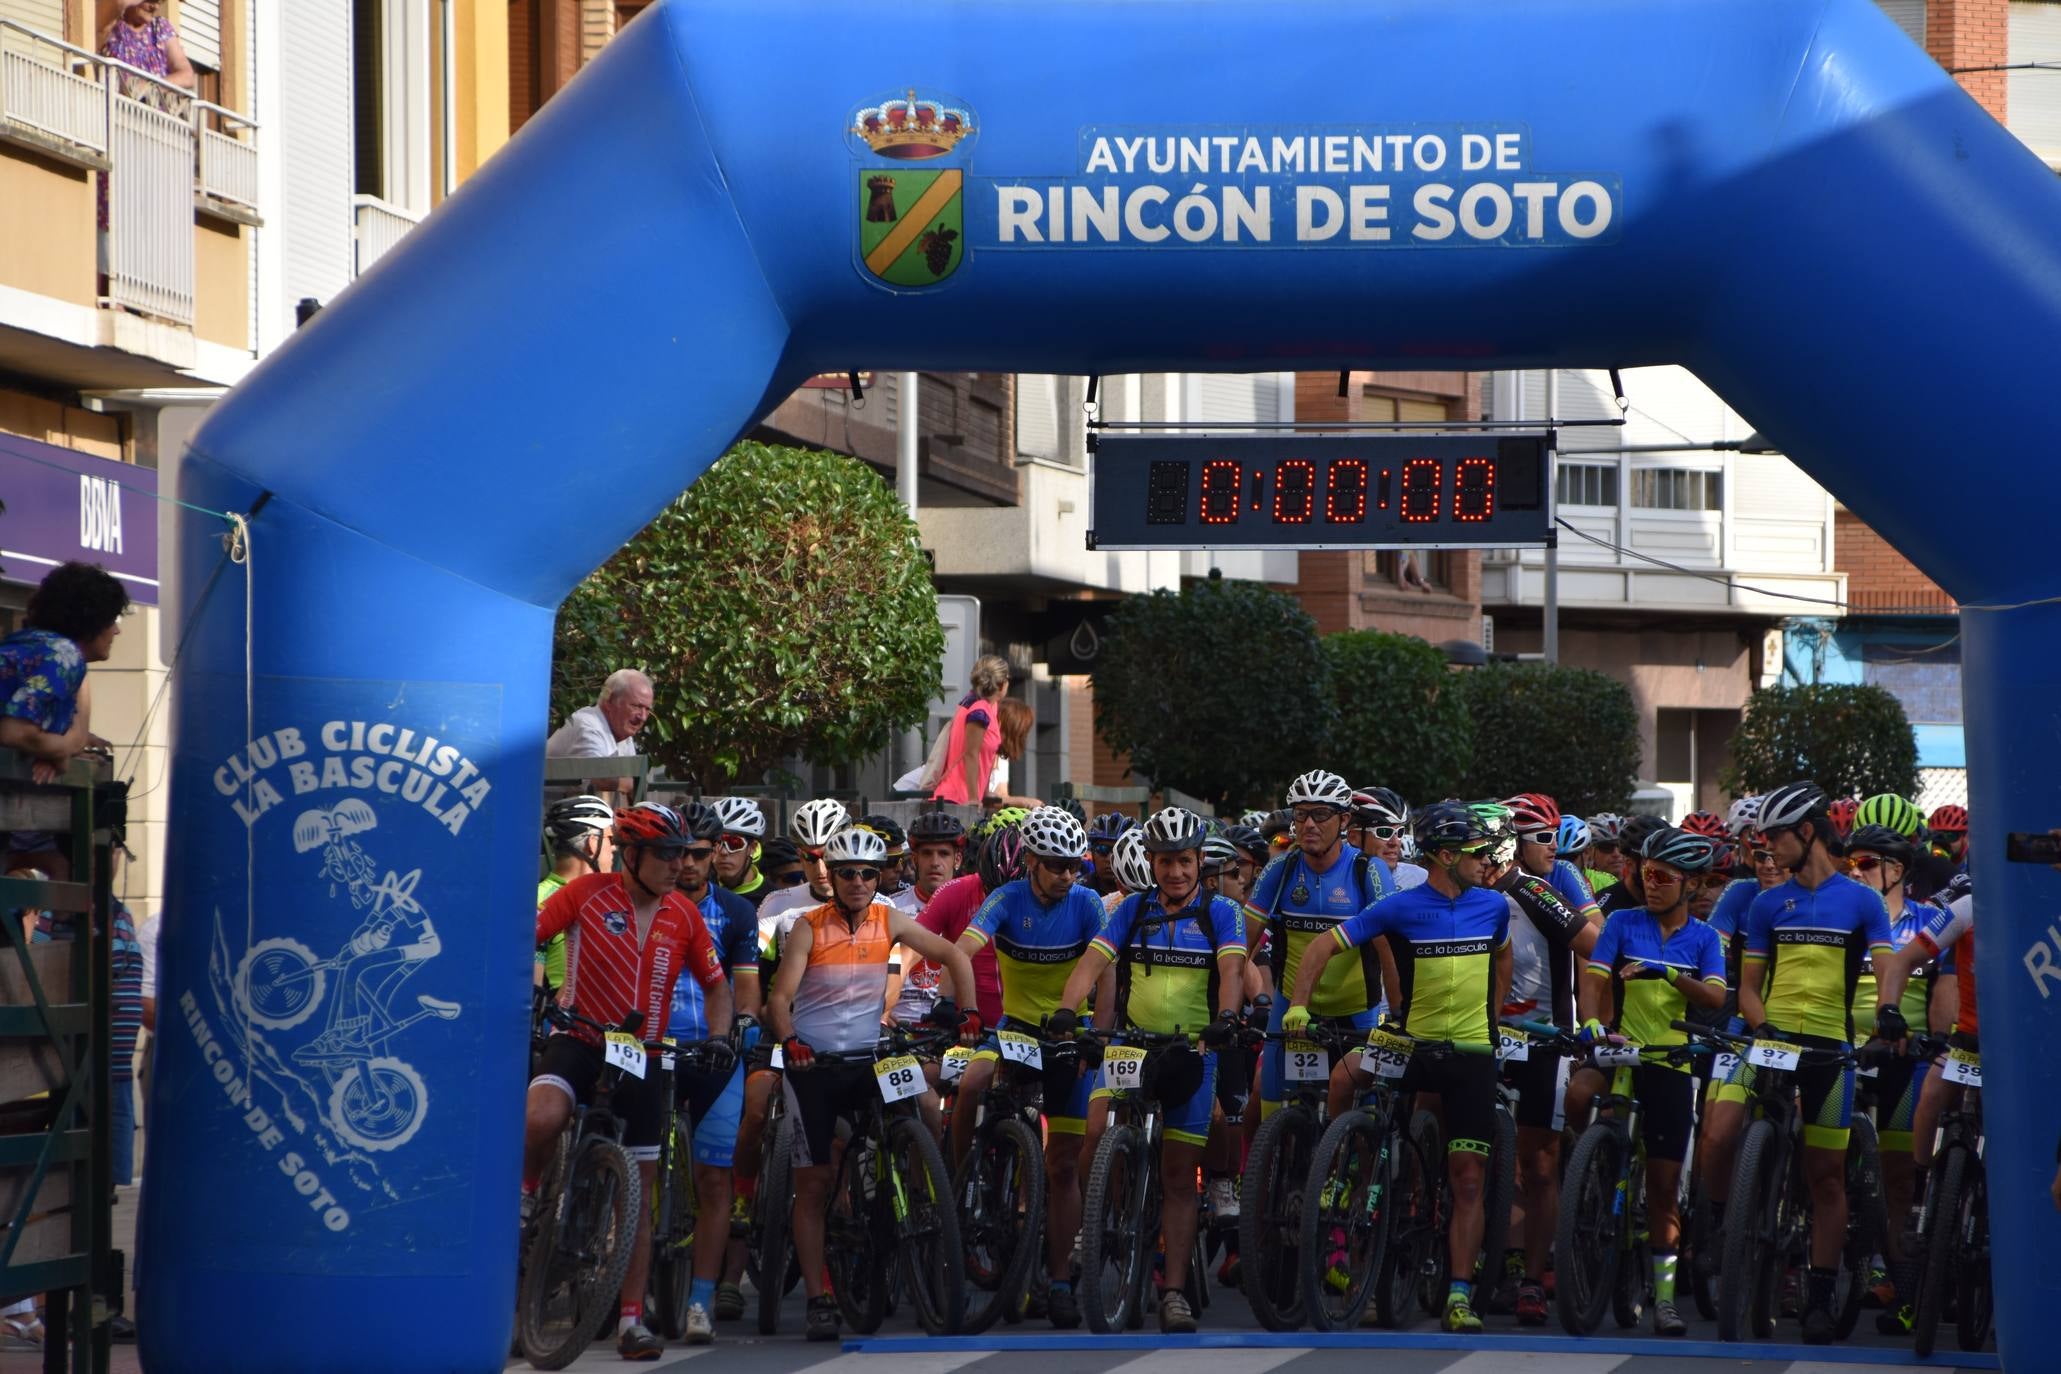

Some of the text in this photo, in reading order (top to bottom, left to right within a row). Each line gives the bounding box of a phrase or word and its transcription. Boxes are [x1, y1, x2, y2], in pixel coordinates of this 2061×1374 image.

[1086, 134, 1521, 174] AYUNTAMIENTO DE
[1297, 185, 1390, 241] DE
[1413, 181, 1613, 240] SOTO
[80, 474, 123, 555] BBVA
[213, 720, 492, 811] CLUB CICLISTA
[230, 756, 471, 837] LA BASCULA
[1303, 919, 1314, 929] la
[1806, 932, 1845, 945] bascula
[1039, 947, 1077, 962] bascula
[1446, 942, 1488, 955] bascula
[1165, 953, 1206, 965] bascula
[1500, 1036, 1524, 1050] 04
[612, 1043, 642, 1064] 161
[946, 1050, 959, 1058] LA
[1106, 1049, 1143, 1059] LA PERA
[1294, 1053, 1319, 1068] 32
[1762, 1049, 1789, 1060] 97
[876, 1057, 915, 1075] LA PERA
[947, 1058, 970, 1070] 22
[1108, 1060, 1138, 1076] 169
[1956, 1063, 1982, 1077] 59
[888, 1068, 914, 1087] 88
[180, 989, 349, 1232] RINCON DE SOTO
